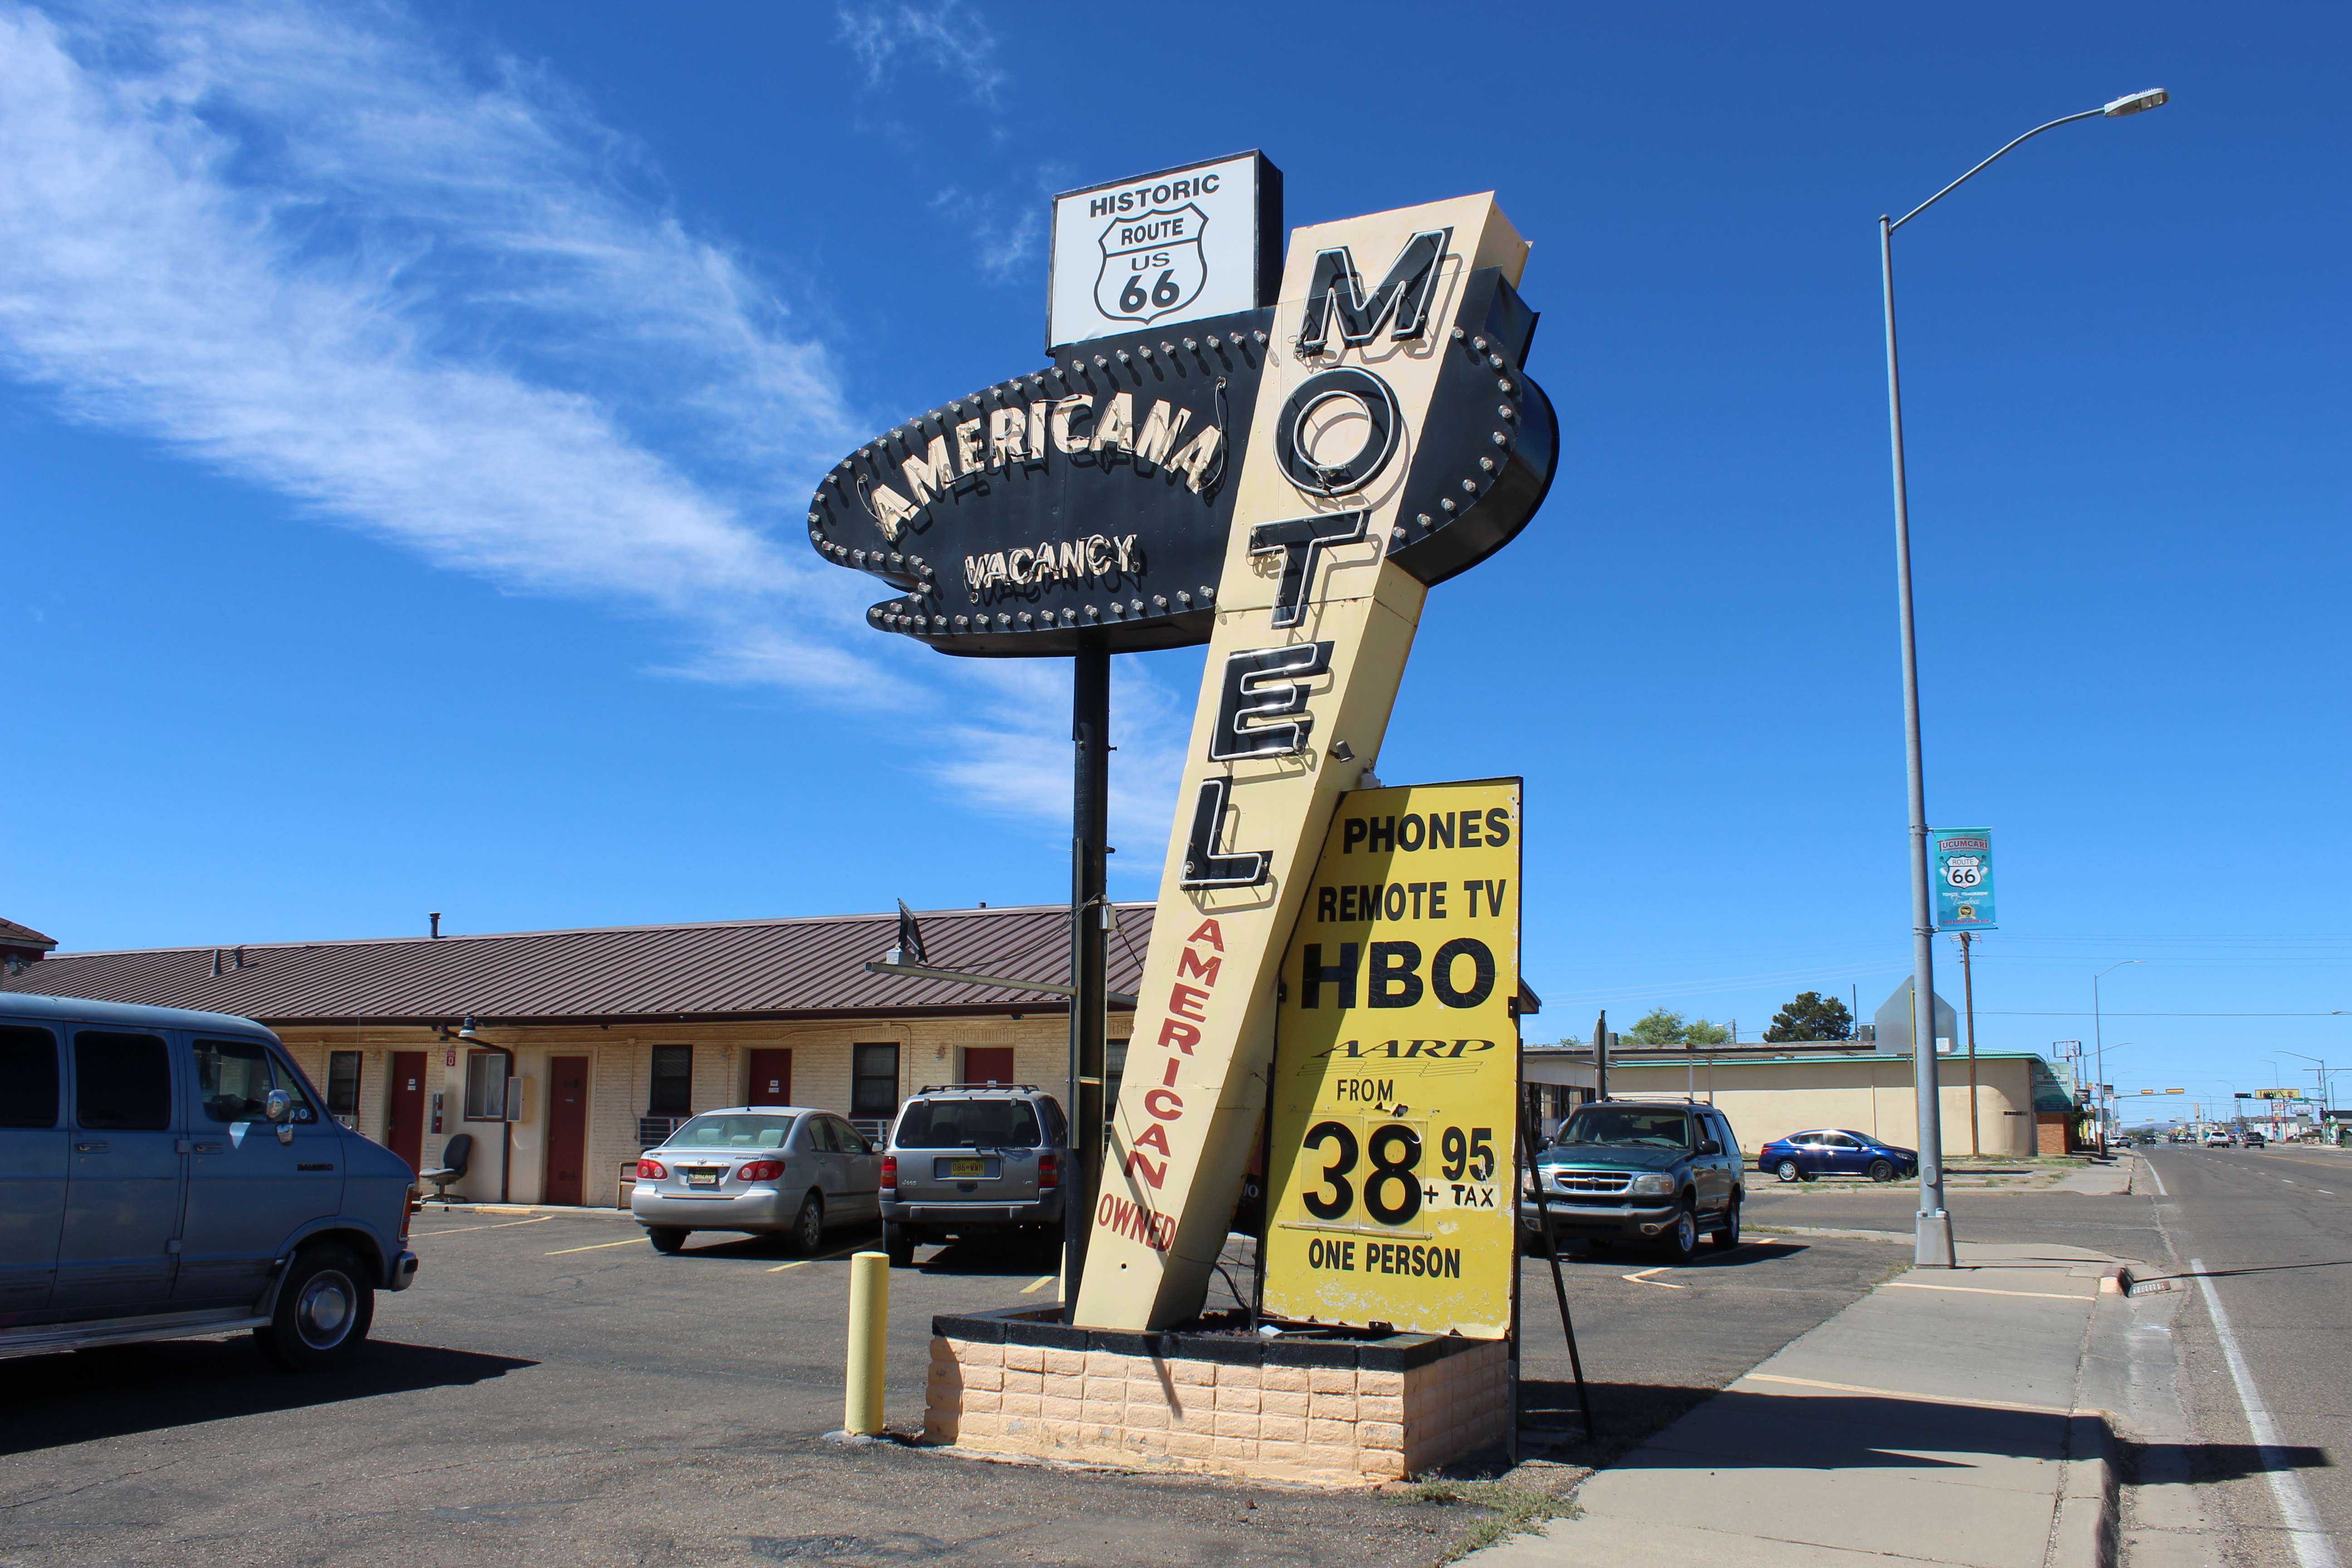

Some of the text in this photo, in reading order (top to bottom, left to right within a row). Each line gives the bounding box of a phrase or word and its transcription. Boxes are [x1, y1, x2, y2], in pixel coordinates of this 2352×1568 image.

[1090, 174, 1220, 218] HISTORIC
[1121, 217, 1184, 246] ROUTE
[1131, 252, 1170, 271] US
[1119, 269, 1180, 314] 66
[871, 392, 1221, 542] AMERICANA
[965, 534, 1137, 589] VACANCY
[1180, 226, 1454, 891] MOTEL
[1343, 808, 1510, 854] PHONES
[1952, 868, 1975, 883] 66
[1318, 879, 1507, 922] REMOTE TV
[1301, 937, 1495, 1009] HBO
[1123, 918, 1224, 1190] AMERICAN
[1311, 1039, 1495, 1058] AARP
[1337, 1079, 1394, 1102] FROM
[953, 1163, 983, 1171] 086 WWH
[1302, 1121, 1422, 1226] 38
[1441, 1126, 1494, 1181] 95
[1451, 1184, 1494, 1207] TAX
[1098, 1193, 1175, 1252] OWNED
[1308, 1238, 1460, 1279] ONE PERSON
